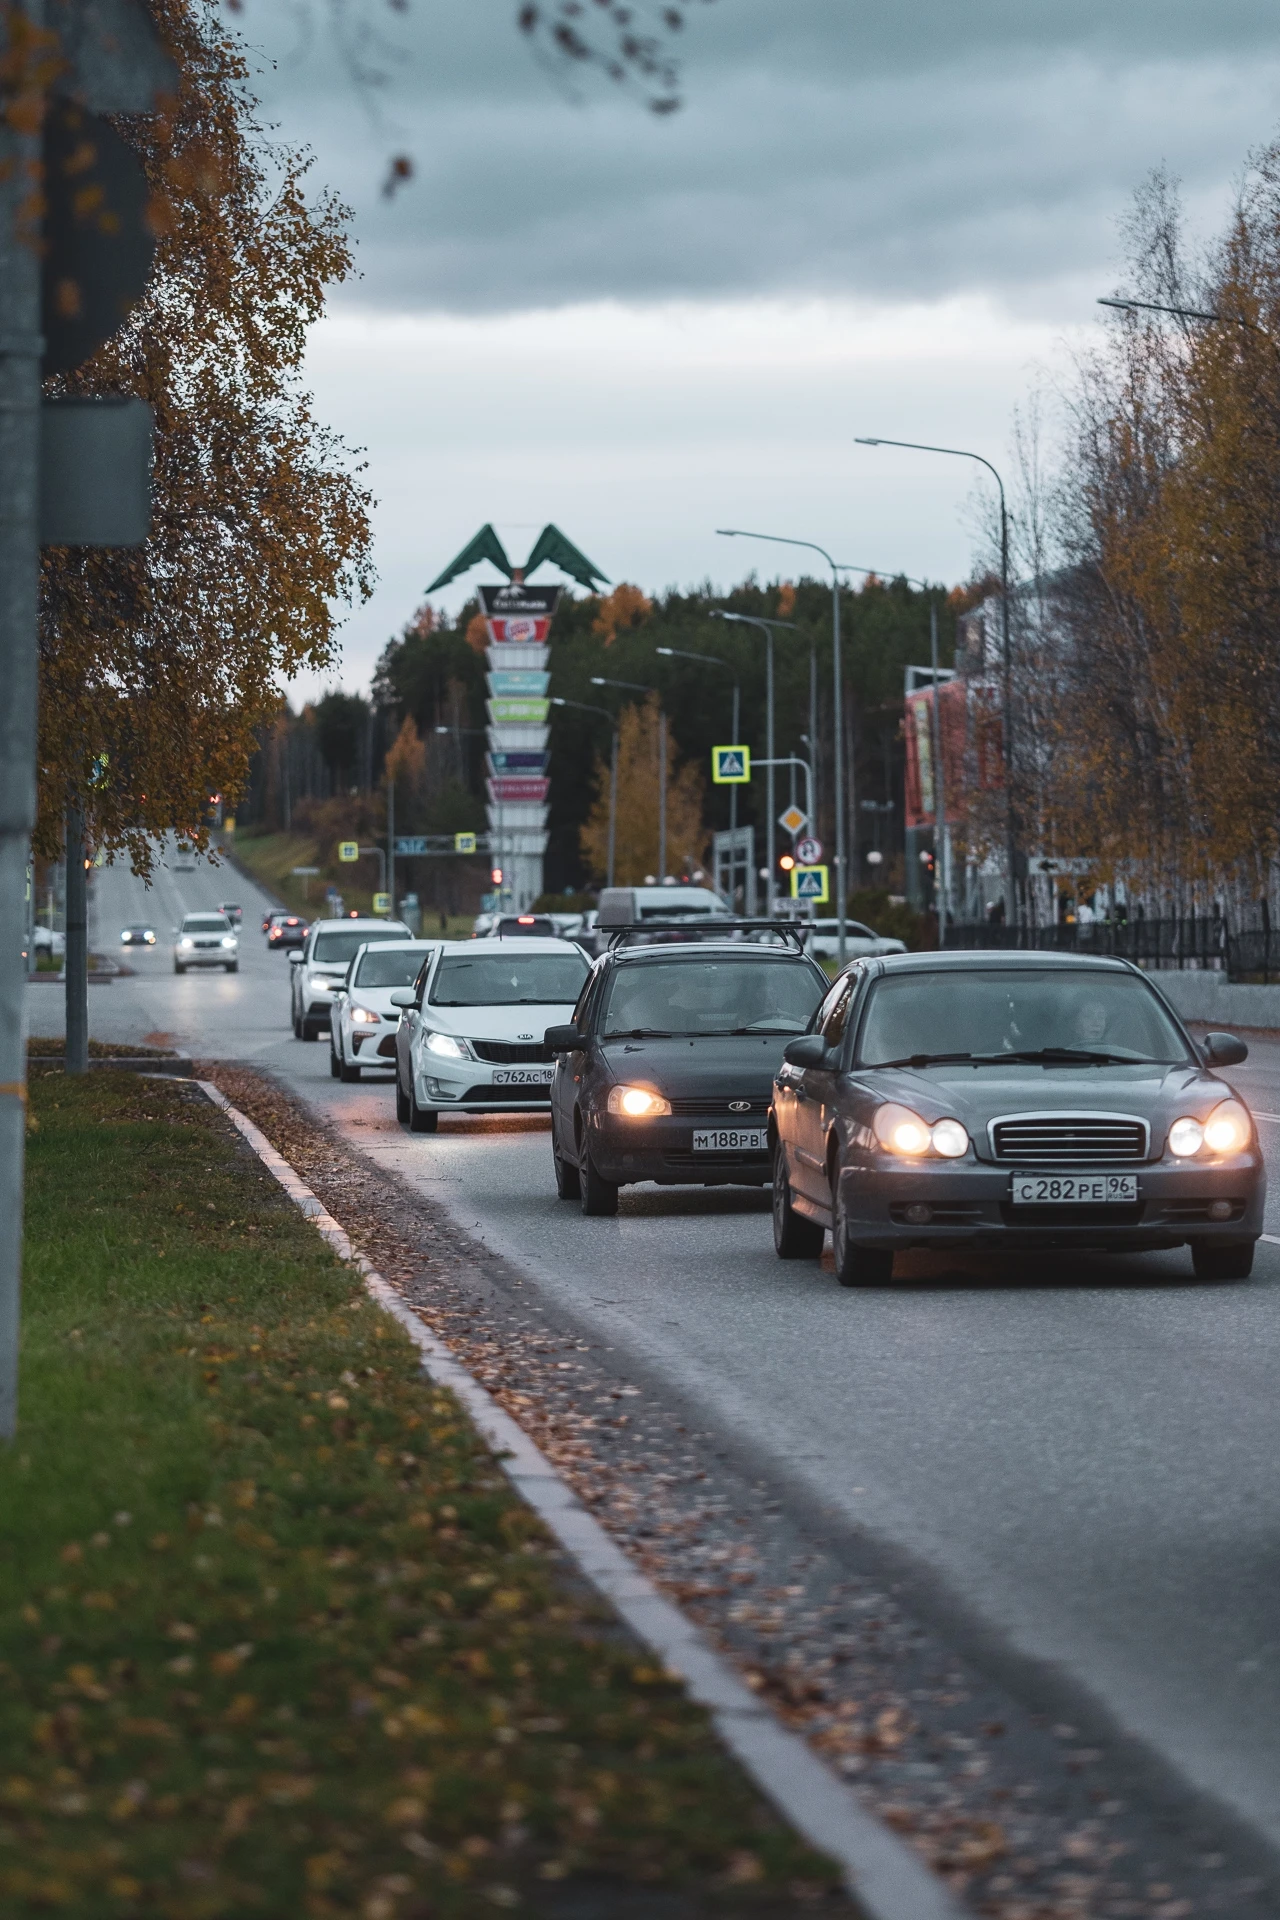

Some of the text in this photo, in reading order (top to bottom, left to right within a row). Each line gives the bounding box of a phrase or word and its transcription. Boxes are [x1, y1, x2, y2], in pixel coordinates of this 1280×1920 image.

[497, 1071, 539, 1083] С762АС
[541, 1070, 555, 1079] 18
[697, 1132, 759, 1148] М188РВ
[1021, 1177, 1130, 1200] С282РЕ 96
